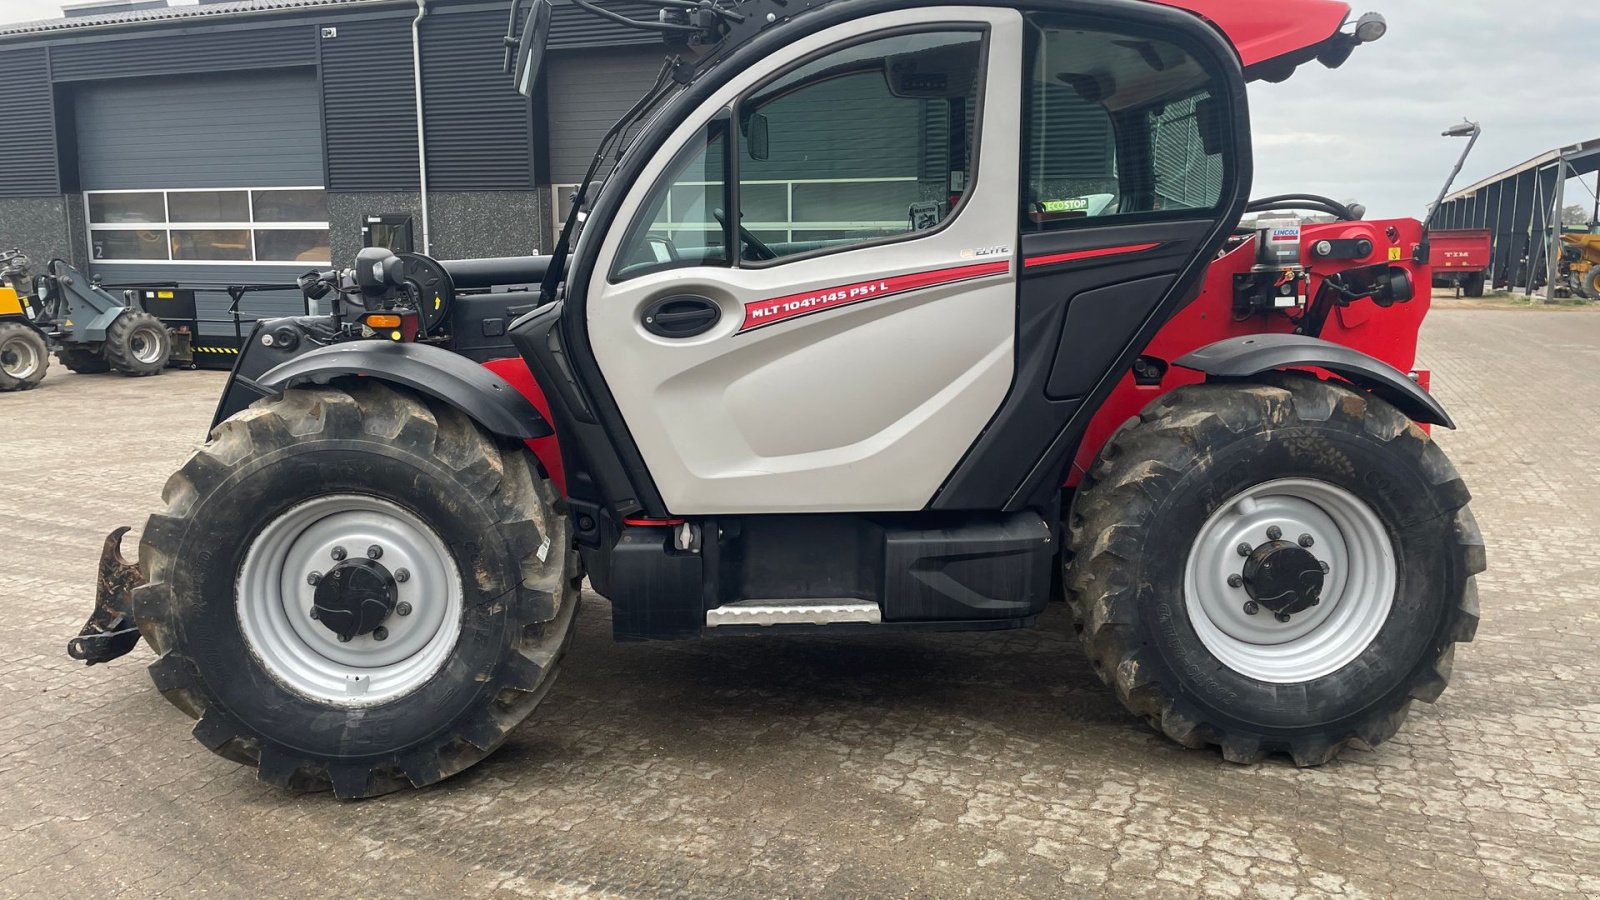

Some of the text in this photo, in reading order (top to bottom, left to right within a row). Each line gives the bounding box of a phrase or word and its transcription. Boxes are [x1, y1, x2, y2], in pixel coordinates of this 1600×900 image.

[1047, 199, 1087, 210] ECOSTOP
[95, 246, 104, 258] 2
[975, 246, 1009, 256] ELITE
[752, 282, 889, 318] MLT 1041-145 PS+ L
